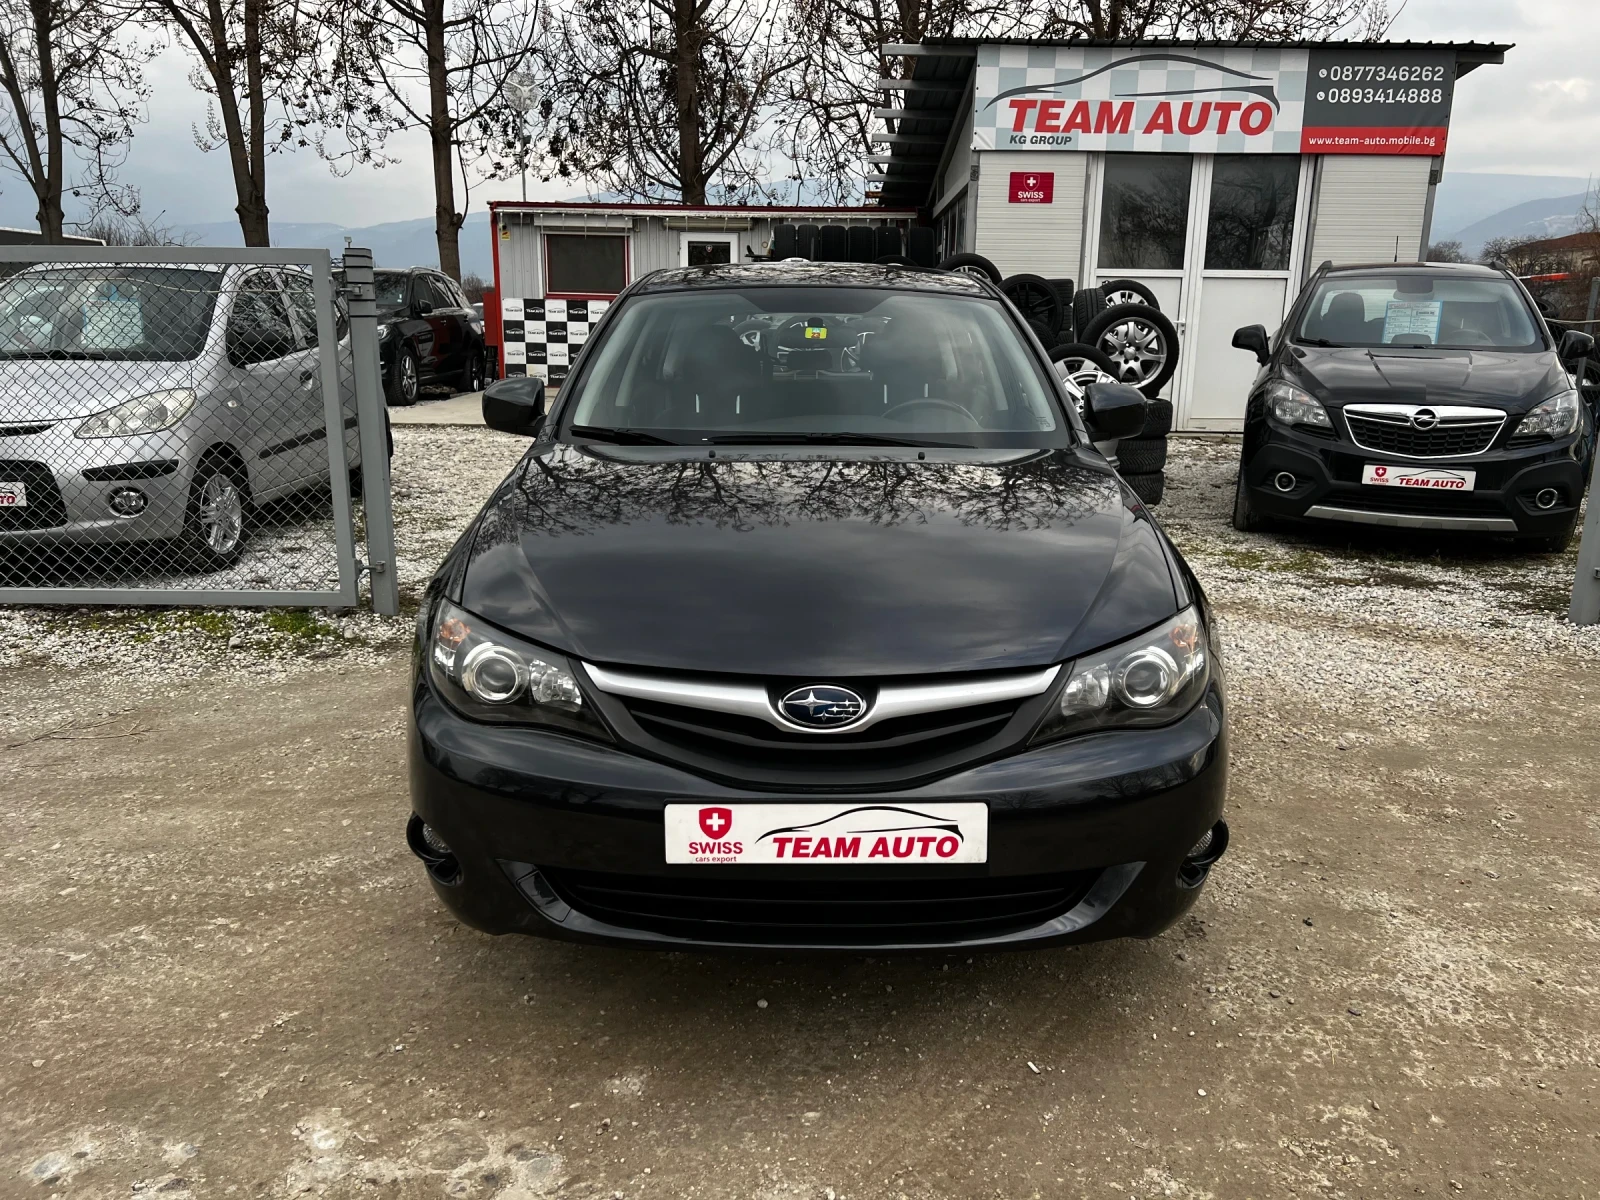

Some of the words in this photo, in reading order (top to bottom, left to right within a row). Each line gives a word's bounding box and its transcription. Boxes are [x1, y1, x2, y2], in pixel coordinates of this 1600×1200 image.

[1330, 65, 1445, 81] 0877346262
[1328, 88, 1442, 104] 0893414888
[1008, 99, 1135, 134] TEAM
[1141, 101, 1273, 136] AUTO
[1009, 134, 1026, 145] KG
[1030, 135, 1072, 146] GROUP
[1308, 135, 1436, 147] www.team-auto.mobile.bg
[1017, 191, 1044, 199] SWISS
[1398, 477, 1431, 487] TEAM
[1431, 479, 1465, 489] AUTO
[0, 495, 16, 505] TO
[688, 841, 744, 855] SWISS
[772, 836, 861, 858] TEAM
[868, 835, 960, 858] AUTO
[711, 856, 737, 864] export
